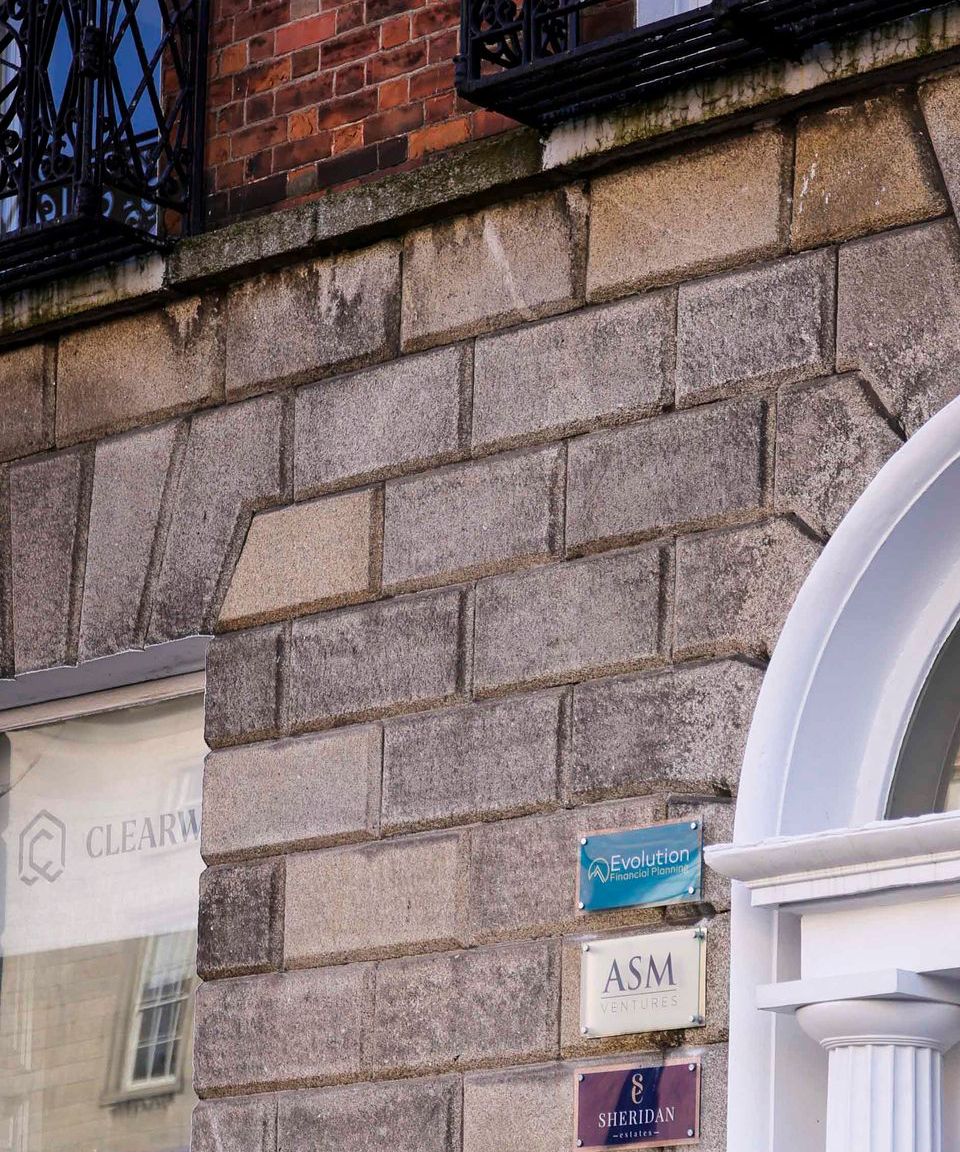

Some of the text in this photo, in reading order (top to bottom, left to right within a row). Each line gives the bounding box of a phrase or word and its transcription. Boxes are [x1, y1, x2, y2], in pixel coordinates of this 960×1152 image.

[610, 848, 690, 872] Evolution
[609, 864, 690, 882] Financial Planning
[602, 952, 677, 994] ASM
[600, 996, 679, 1016] VENTURES
[598, 1106, 676, 1128] SHERIDAN
